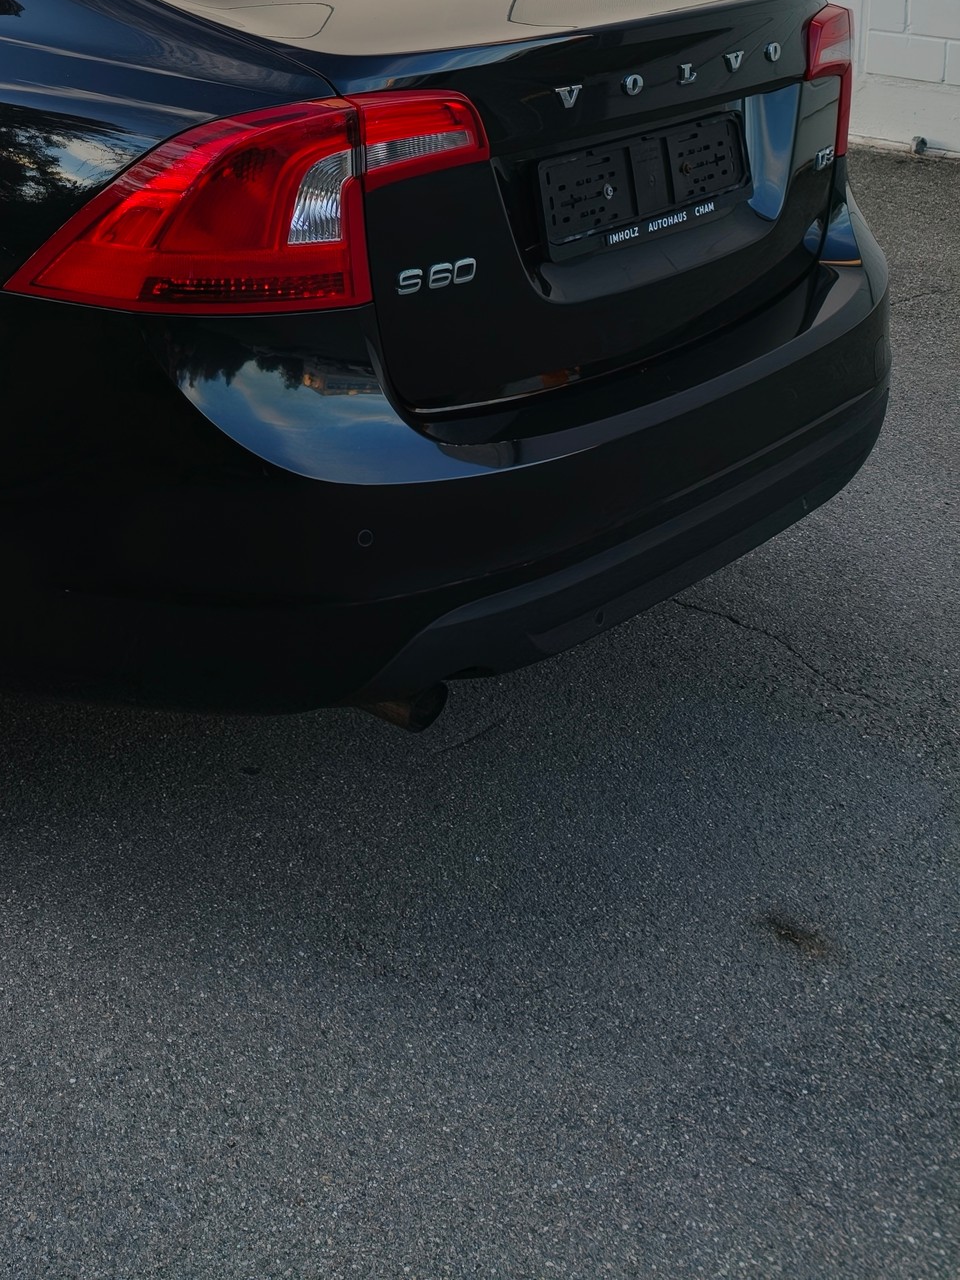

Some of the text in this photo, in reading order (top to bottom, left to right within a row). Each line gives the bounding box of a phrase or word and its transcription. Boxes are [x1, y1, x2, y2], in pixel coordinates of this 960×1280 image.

[555, 42, 781, 108] VOLVO
[609, 202, 715, 244] IMHOLZ AUTOHAUS CHAM
[396, 257, 476, 296] S60
